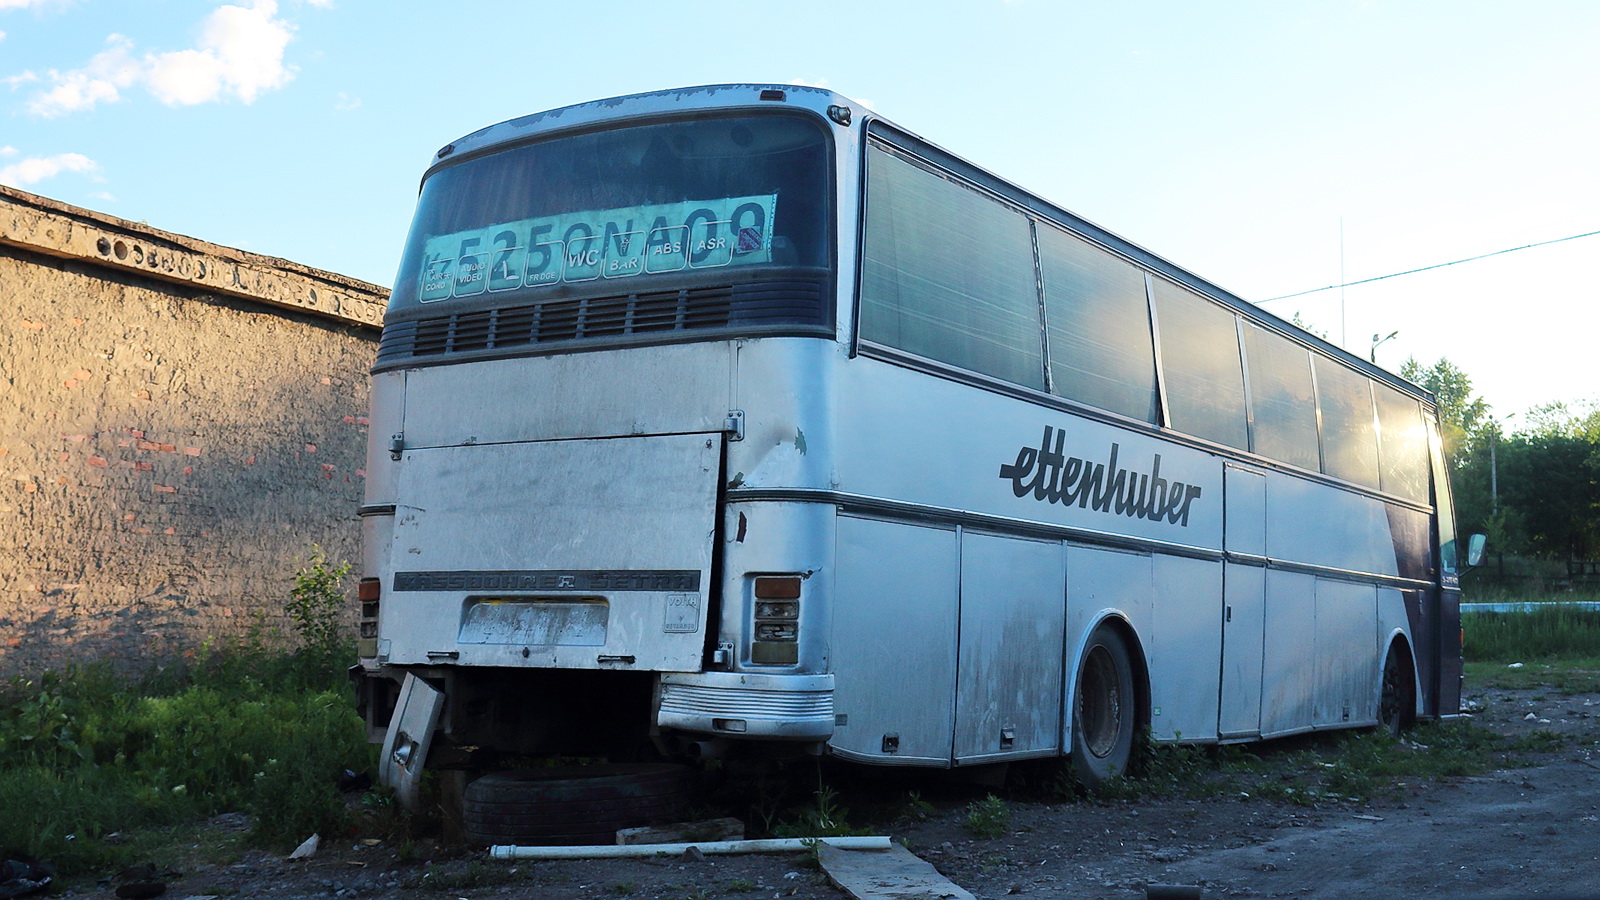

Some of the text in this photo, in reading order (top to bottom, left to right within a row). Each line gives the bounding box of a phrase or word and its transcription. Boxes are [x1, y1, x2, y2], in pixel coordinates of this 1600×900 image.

[653, 241, 682, 255] ABS
[696, 237, 726, 250] ASR
[569, 250, 600, 267] WC
[610, 257, 638, 271] BAR
[460, 273, 483, 283] VIDEO
[529, 271, 556, 282] FRDGE
[425, 281, 446, 292] COND
[999, 425, 1202, 527] ettenhuber
[590, 573, 693, 590] SETRA
